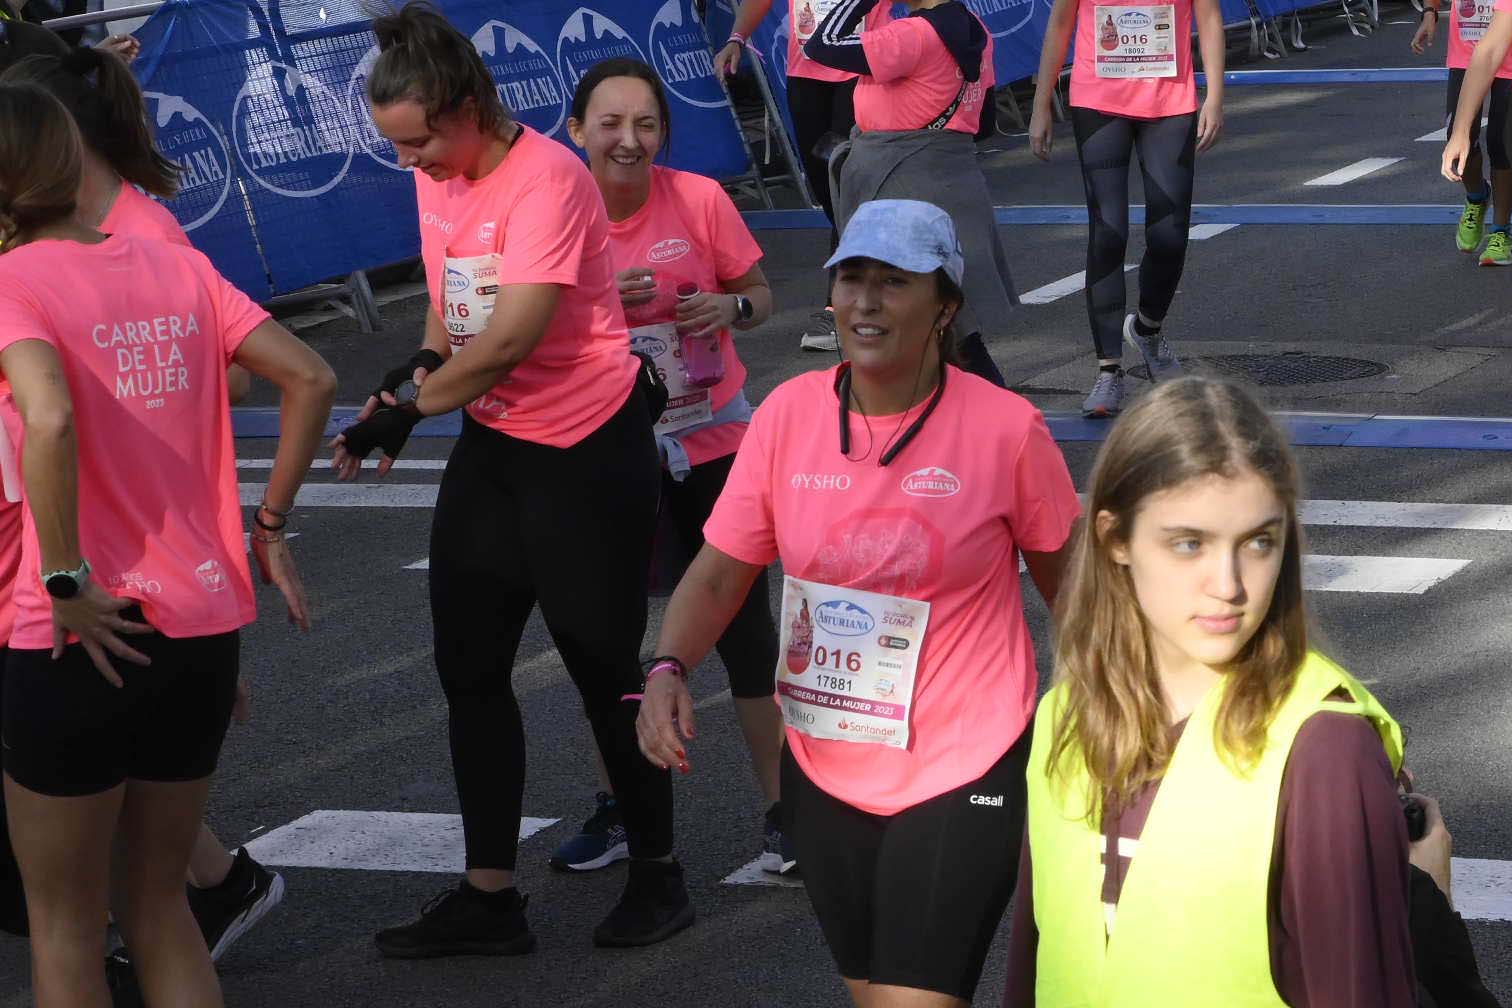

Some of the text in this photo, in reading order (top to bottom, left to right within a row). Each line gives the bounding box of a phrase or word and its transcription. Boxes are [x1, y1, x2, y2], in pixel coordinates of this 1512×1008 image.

[1121, 35, 1148, 45] 016
[93, 312, 200, 349] CARRERA
[117, 343, 184, 374] DE LA
[115, 366, 190, 400] MUJER
[818, 610, 869, 631] ASTURIANA
[814, 645, 862, 672] 016
[816, 674, 853, 693] 17881
[817, 696, 828, 705] DE
[829, 697, 841, 707] LA
[842, 700, 872, 712] MUJER
[873, 705, 895, 715] 2023
[849, 721, 896, 737] Santander
[969, 792, 1004, 807] casall
